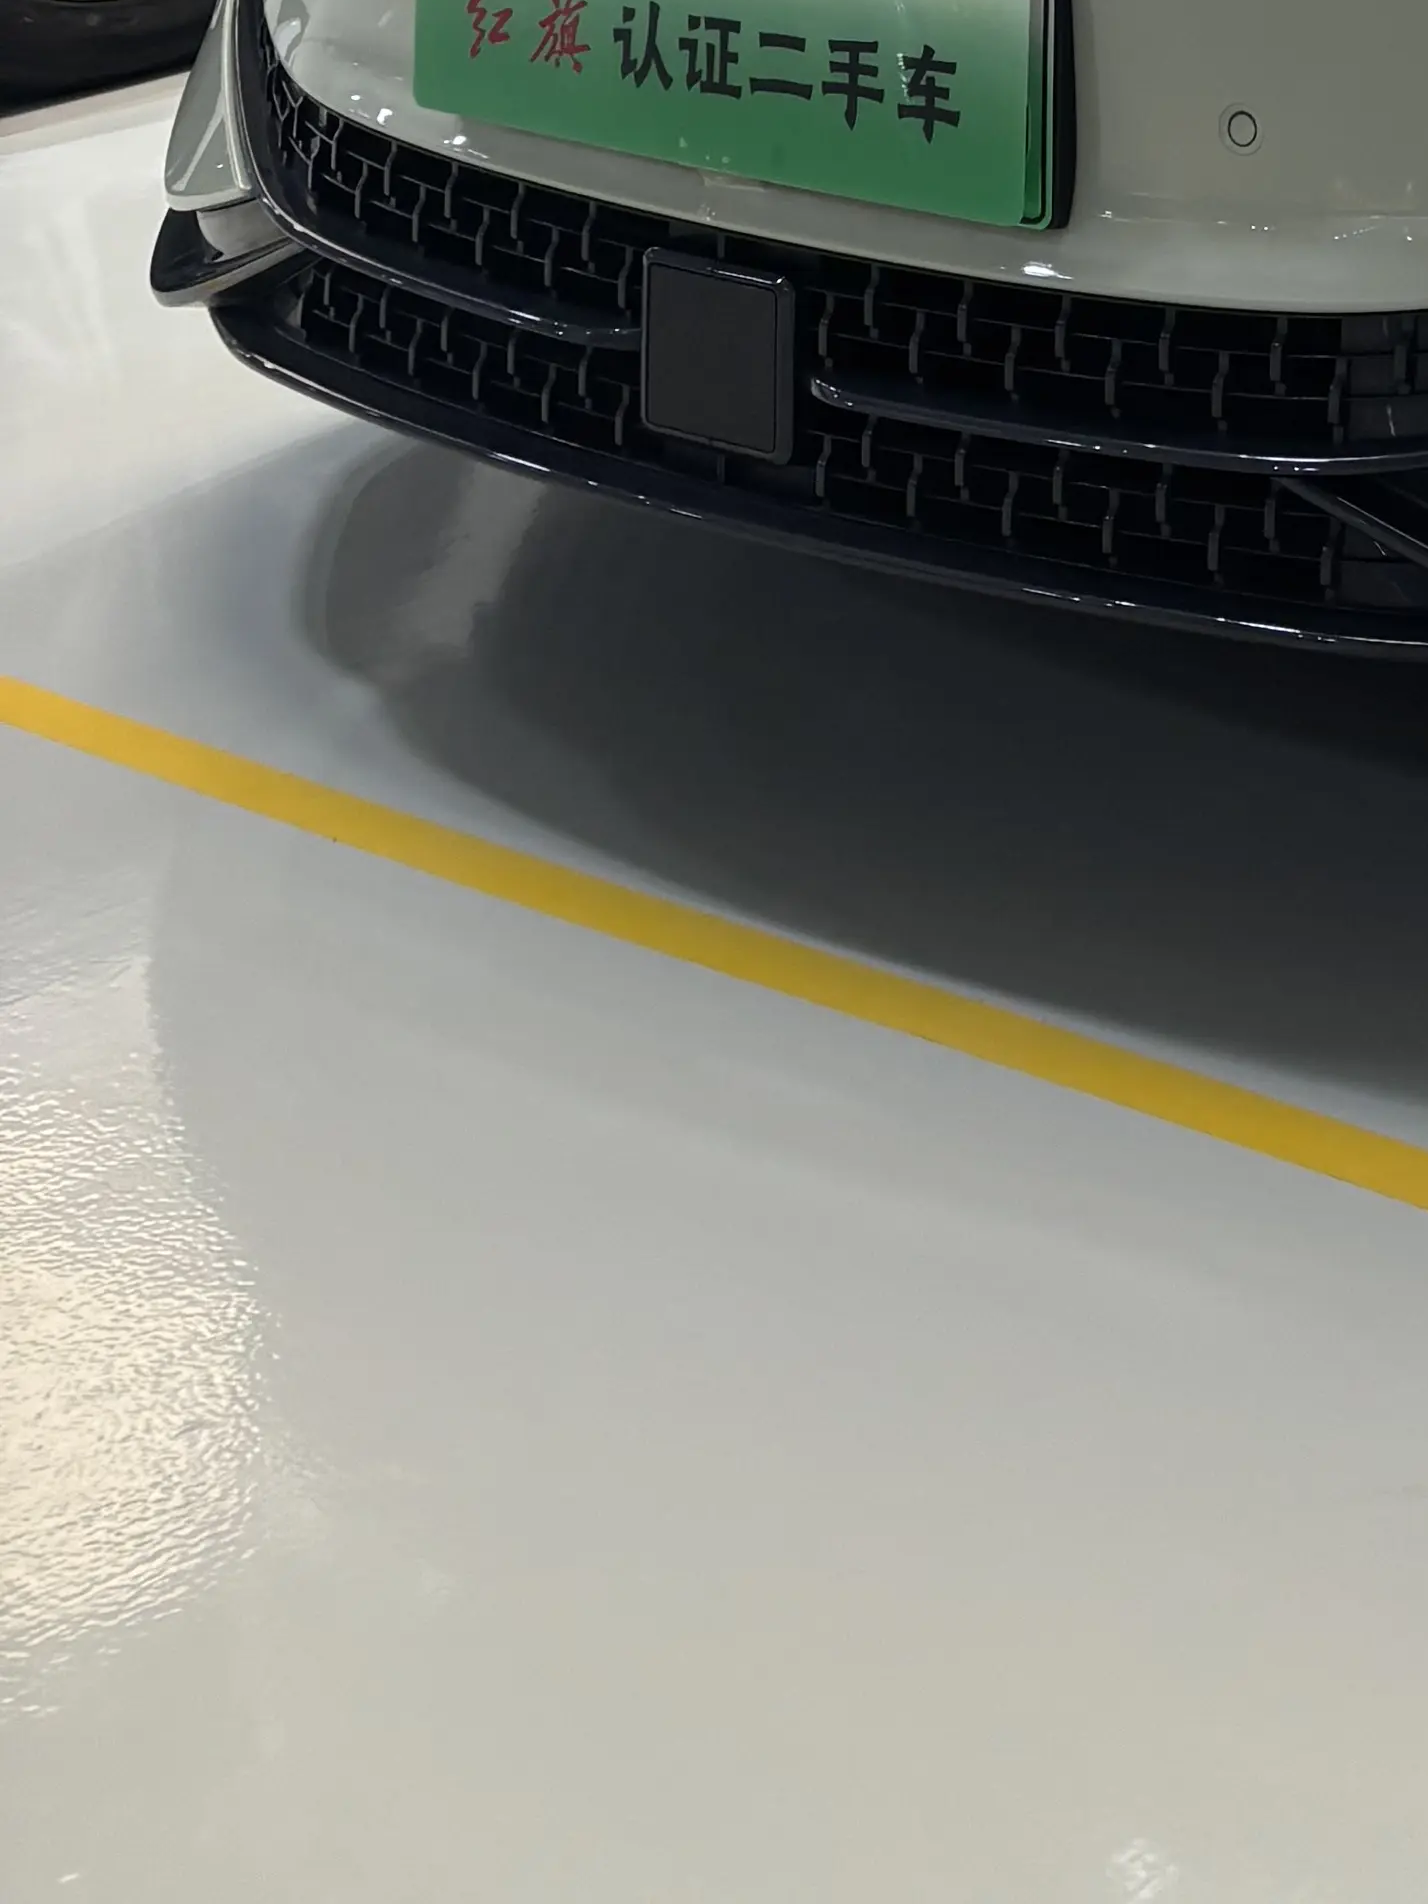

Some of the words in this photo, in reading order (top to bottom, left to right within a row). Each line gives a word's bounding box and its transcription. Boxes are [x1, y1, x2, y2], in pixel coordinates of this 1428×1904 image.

[611, 0, 962, 144] 认证二手车
